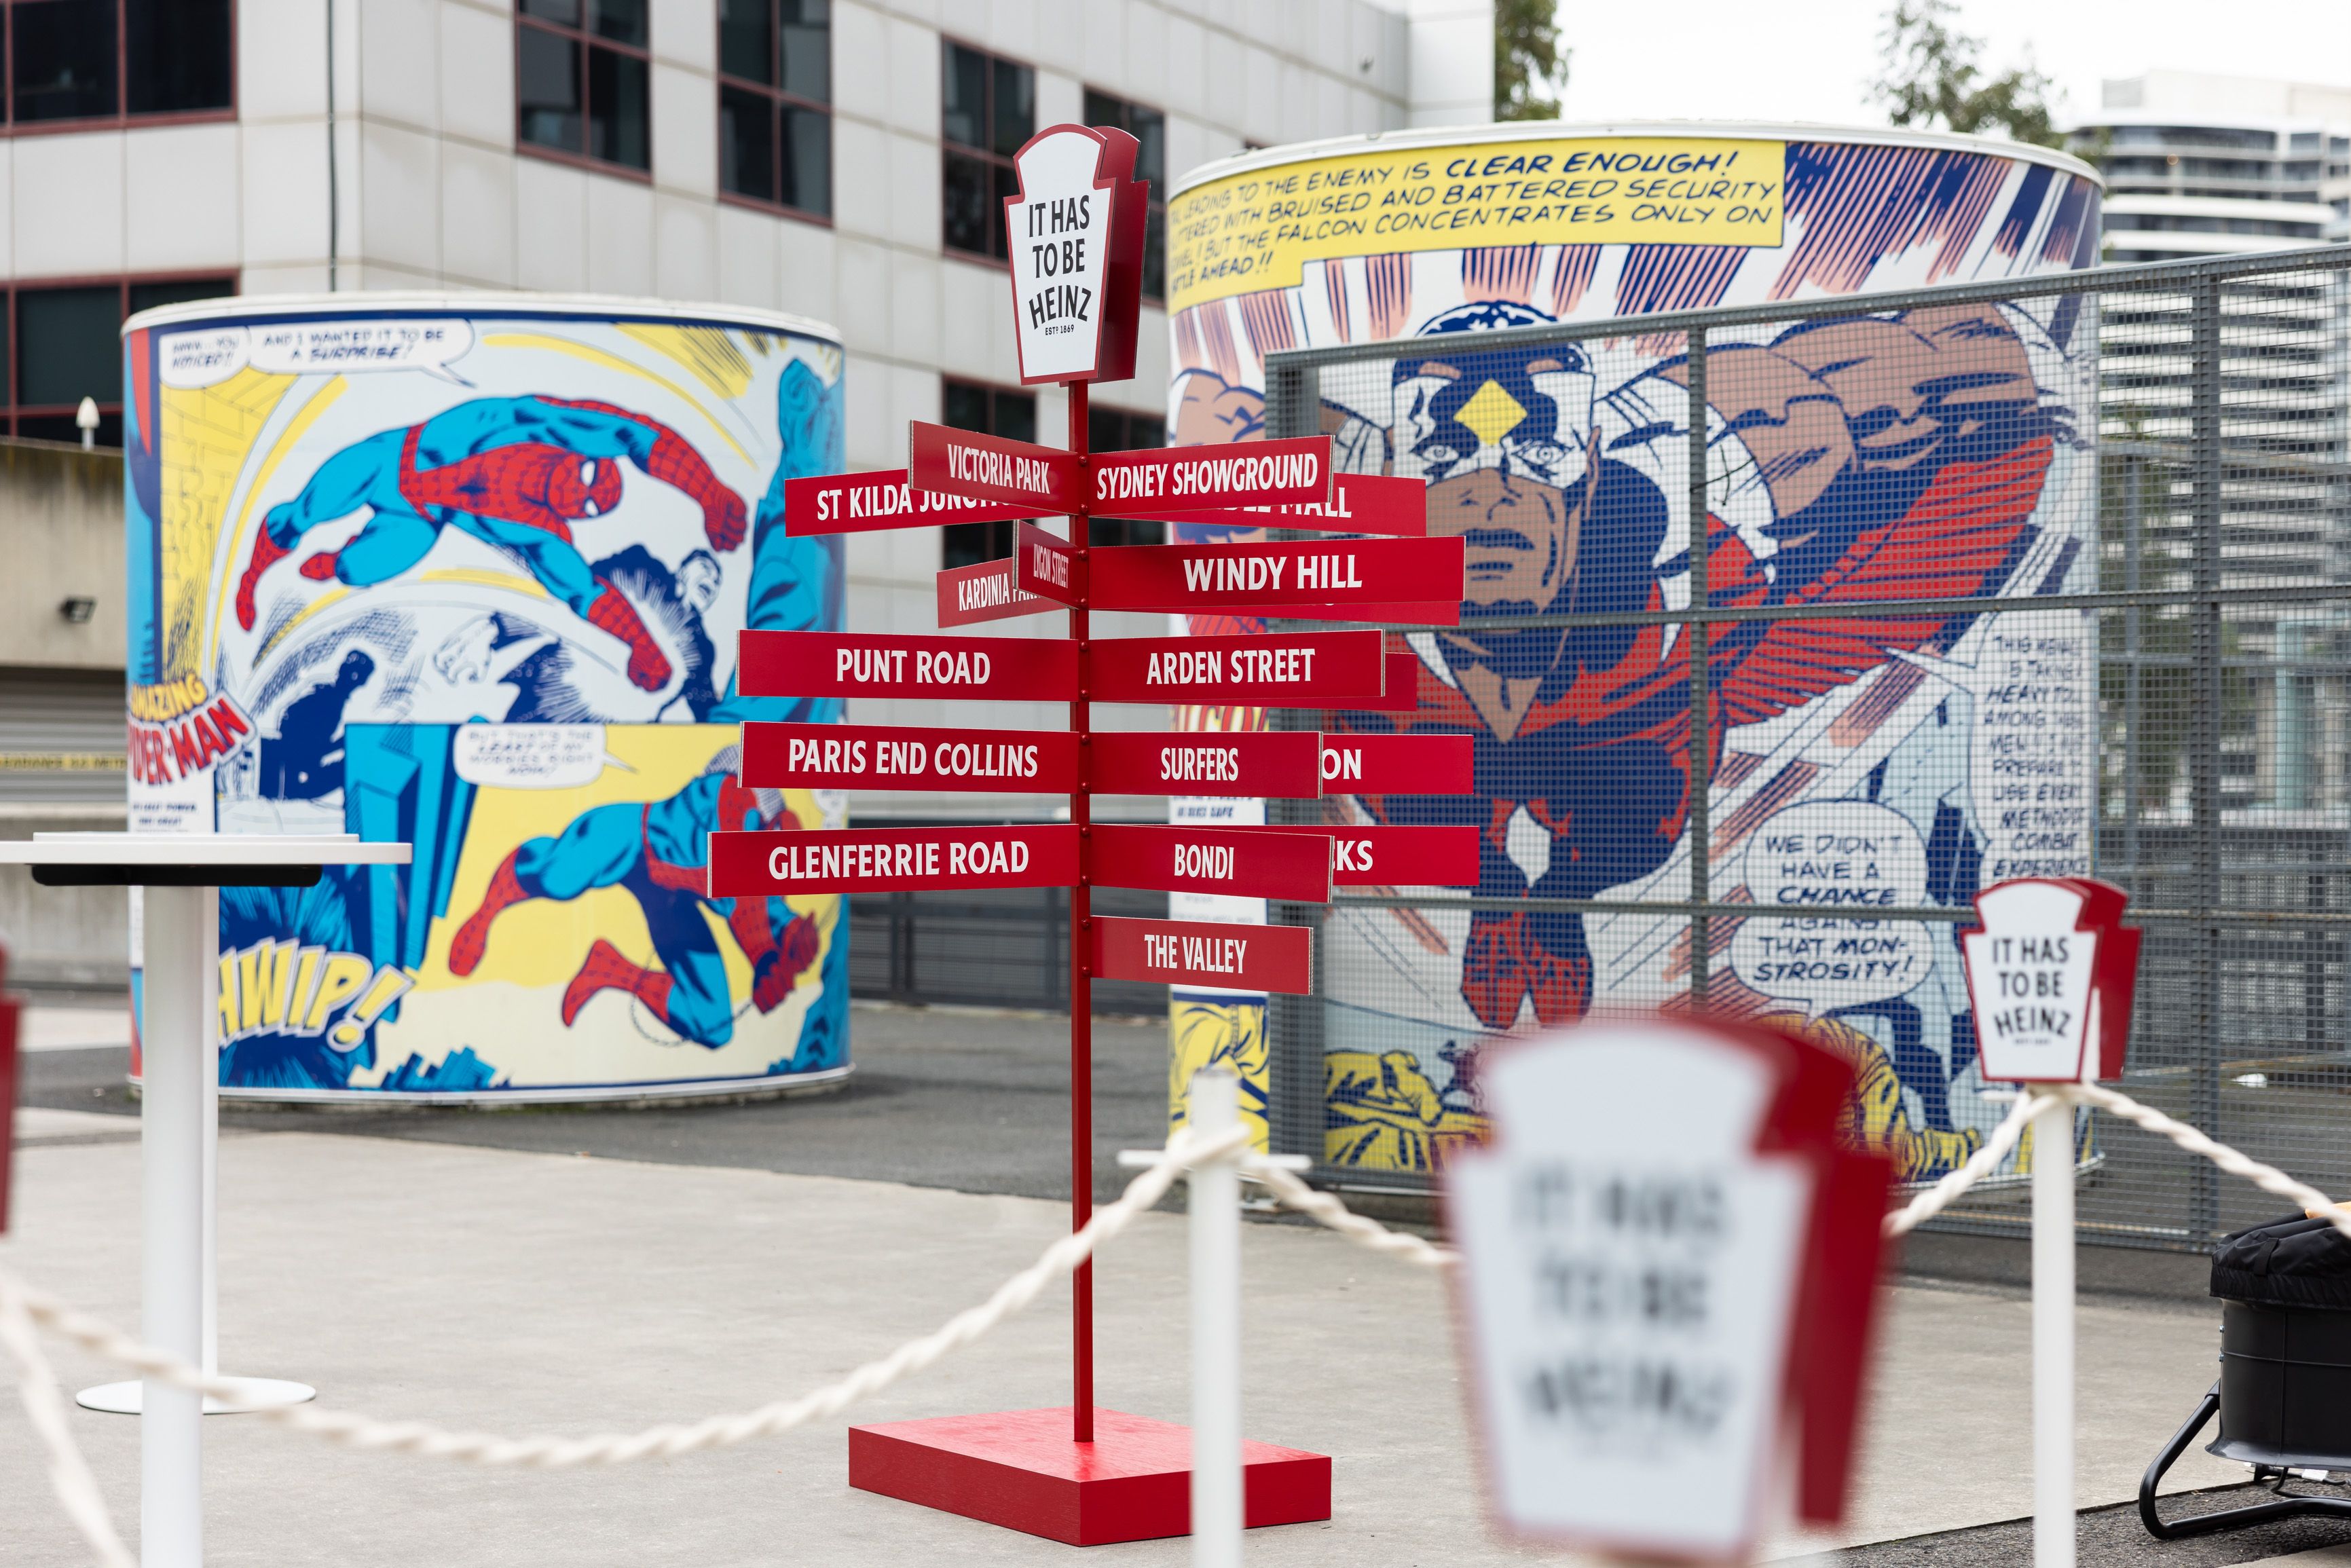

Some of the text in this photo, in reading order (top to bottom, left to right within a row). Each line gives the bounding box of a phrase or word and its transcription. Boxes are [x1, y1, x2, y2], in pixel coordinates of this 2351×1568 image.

[1238, 183, 1259, 202] TO
[1266, 176, 1299, 196] THE
[1307, 167, 1393, 191] ENEMY
[1403, 162, 1430, 180] IS
[1447, 155, 1553, 177] CLEAR
[1563, 151, 1738, 176] ENOUGH!
[1029, 195, 1090, 238] IT HAS
[1225, 208, 1263, 229] WITH
[1268, 193, 1371, 223] BRUISED
[1381, 187, 1434, 207] AND
[1443, 179, 1618, 204] BATTERED
[1625, 179, 1776, 200] SECURITY
[1238, 230, 1270, 251] THE
[1276, 218, 1367, 242] FALCON
[1375, 204, 1614, 234] CONCENTRATES
[1631, 204, 1715, 223] ONLY
[1726, 206, 1772, 223] ON
[1033, 238, 1085, 278] TO BE
[1029, 285, 1091, 330] HEINZ
[425, 329, 444, 340] BE
[1060, 324, 1074, 333] 1869
[948, 443, 1050, 494] VICTORIA PARK
[1097, 453, 1318, 500] SYDNEY SHOWGROUND
[817, 489, 843, 521] ST
[849, 483, 913, 518] KILDA
[1033, 543, 1069, 589] LYGON STREET
[1183, 555, 1363, 592] WINDY HILL
[959, 573, 1010, 612] KARDINIA
[836, 648, 991, 684] PUNT ROAD
[1147, 648, 1316, 685] ARDEN STREET
[128, 698, 248, 785] DER-MAN
[788, 739, 1038, 777] PARIS END COLLINS
[1161, 747, 1239, 781] SURFERS
[769, 841, 1029, 880] GLENFERRIE ROAD
[1174, 844, 1234, 880] BONDI
[1333, 840, 1373, 872] KS
[1766, 834, 1902, 855] WE DIDN'T
[1781, 861, 1879, 880] HAVE A
[1777, 885, 1898, 905] CHANCE
[1145, 934, 1247, 974] THE VALLEY
[1758, 936, 1908, 956] THAT MON-
[1992, 937, 2070, 964] IT HAS
[1753, 954, 1914, 982] STROSITY!
[1999, 971, 2063, 998] TO BE
[1994, 1006, 2072, 1038] HEINZ
